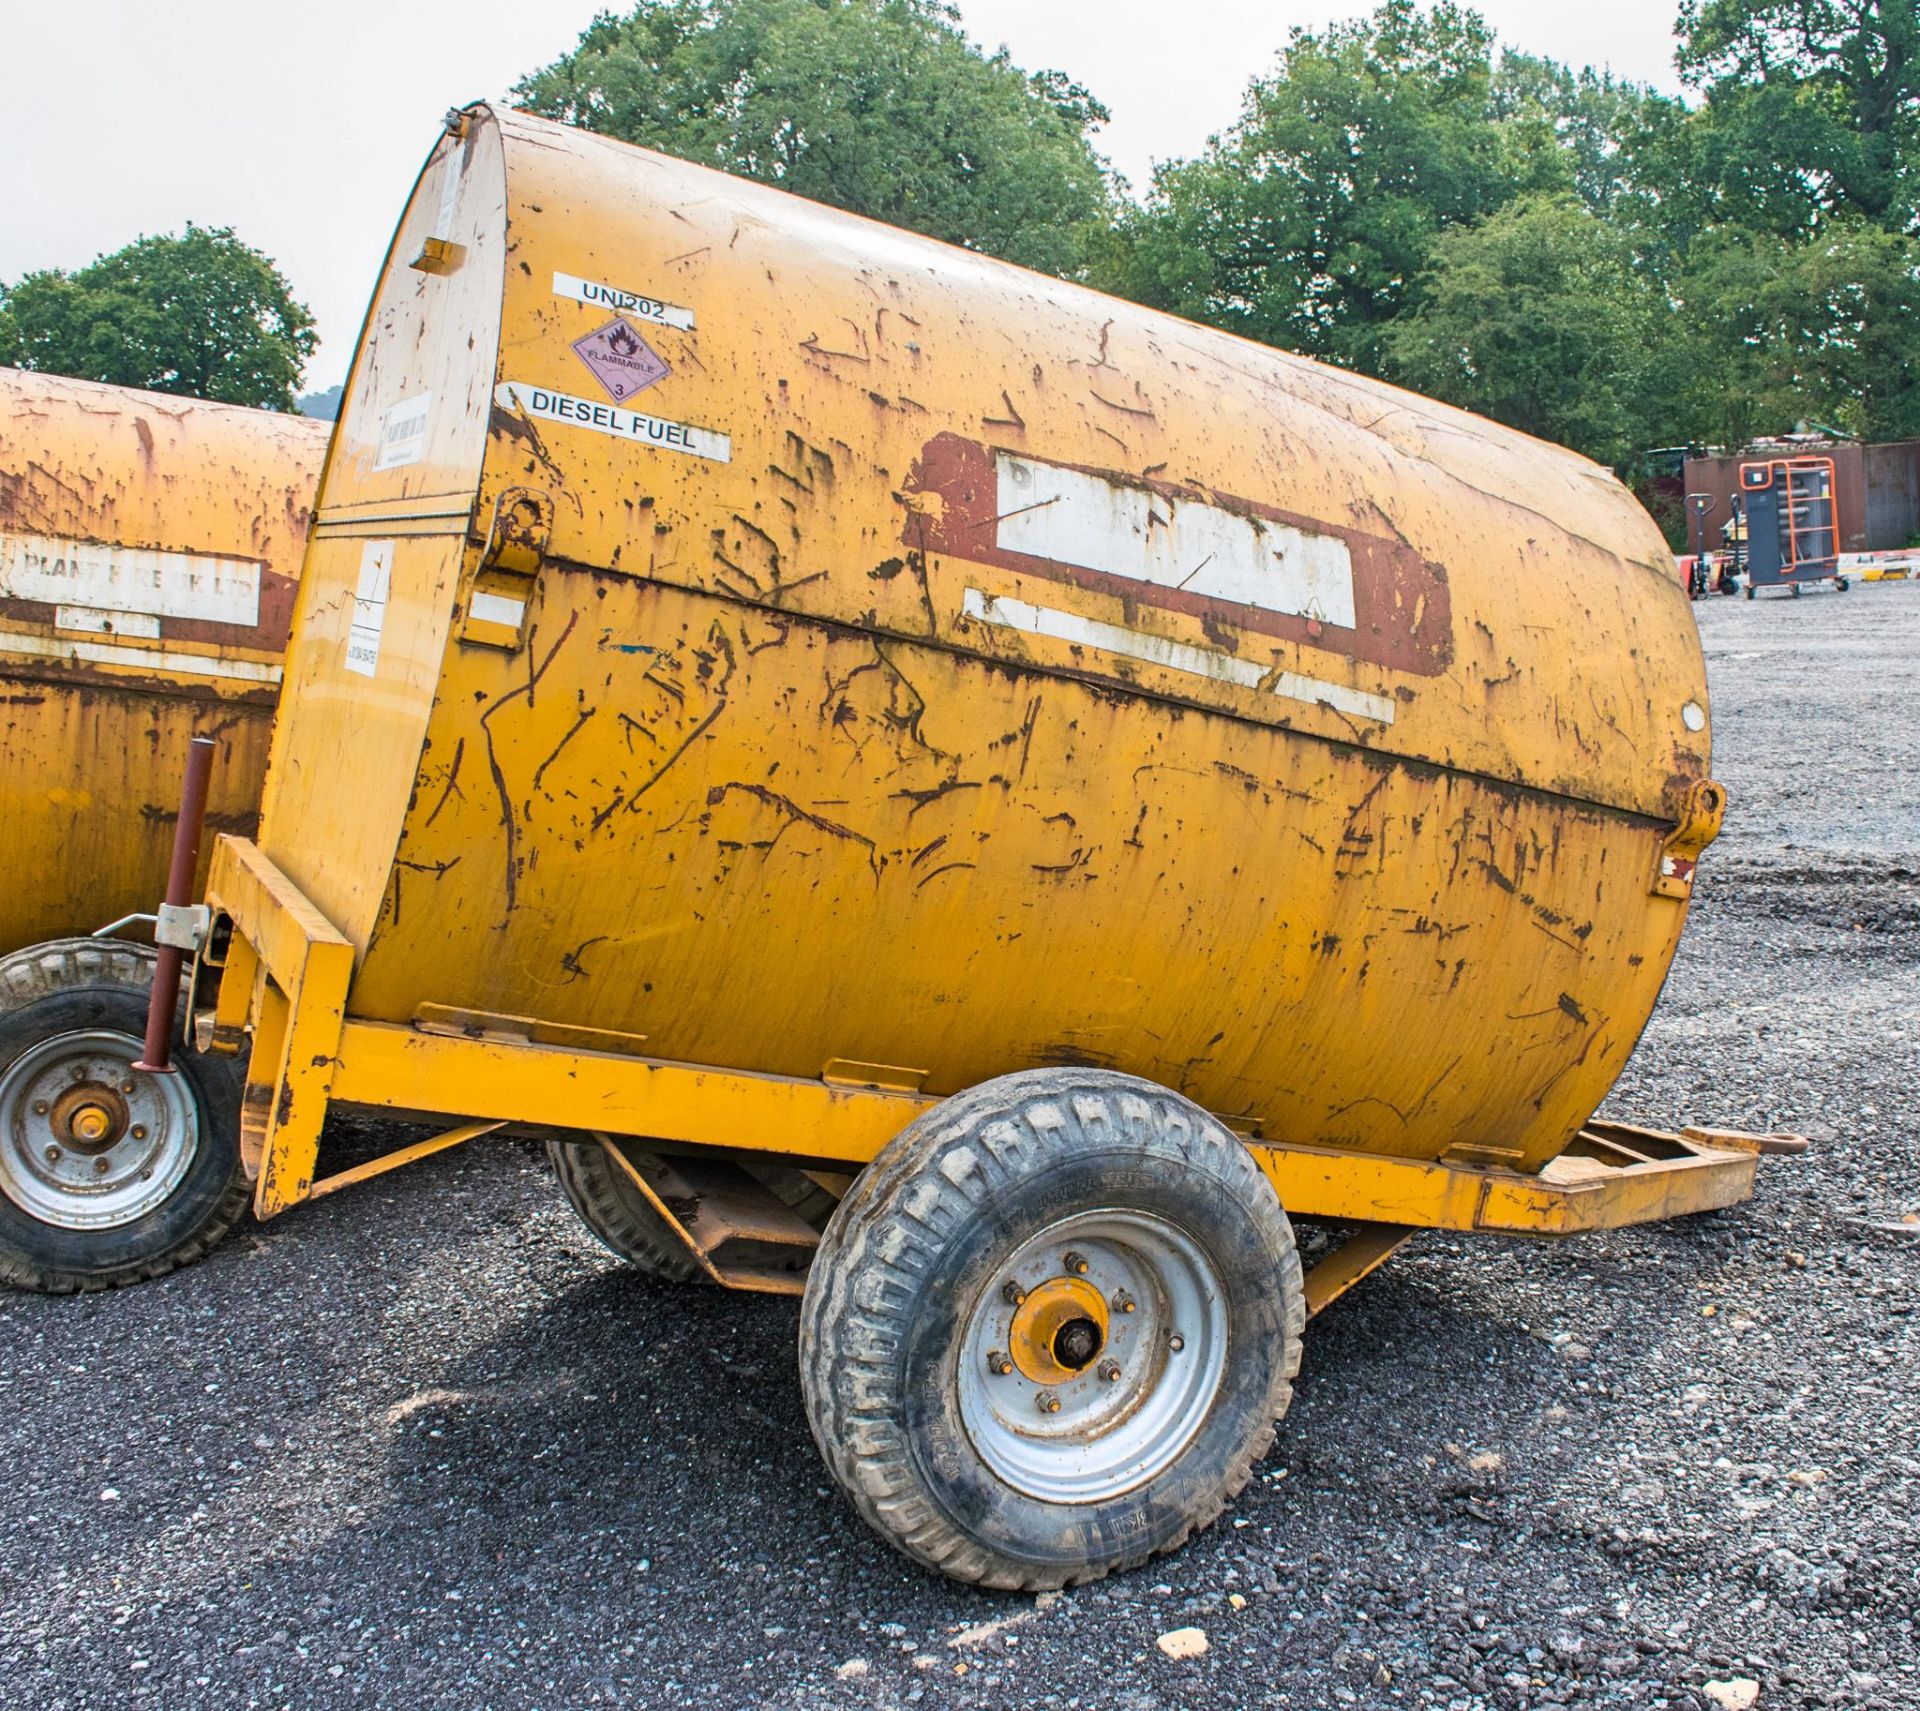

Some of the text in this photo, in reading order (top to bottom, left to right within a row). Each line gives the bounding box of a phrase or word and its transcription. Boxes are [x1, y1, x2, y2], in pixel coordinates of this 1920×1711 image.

[588, 349, 655, 374] FLAMMABLE
[614, 383, 624, 396] 3
[532, 391, 697, 448] DIESEL FUEL
